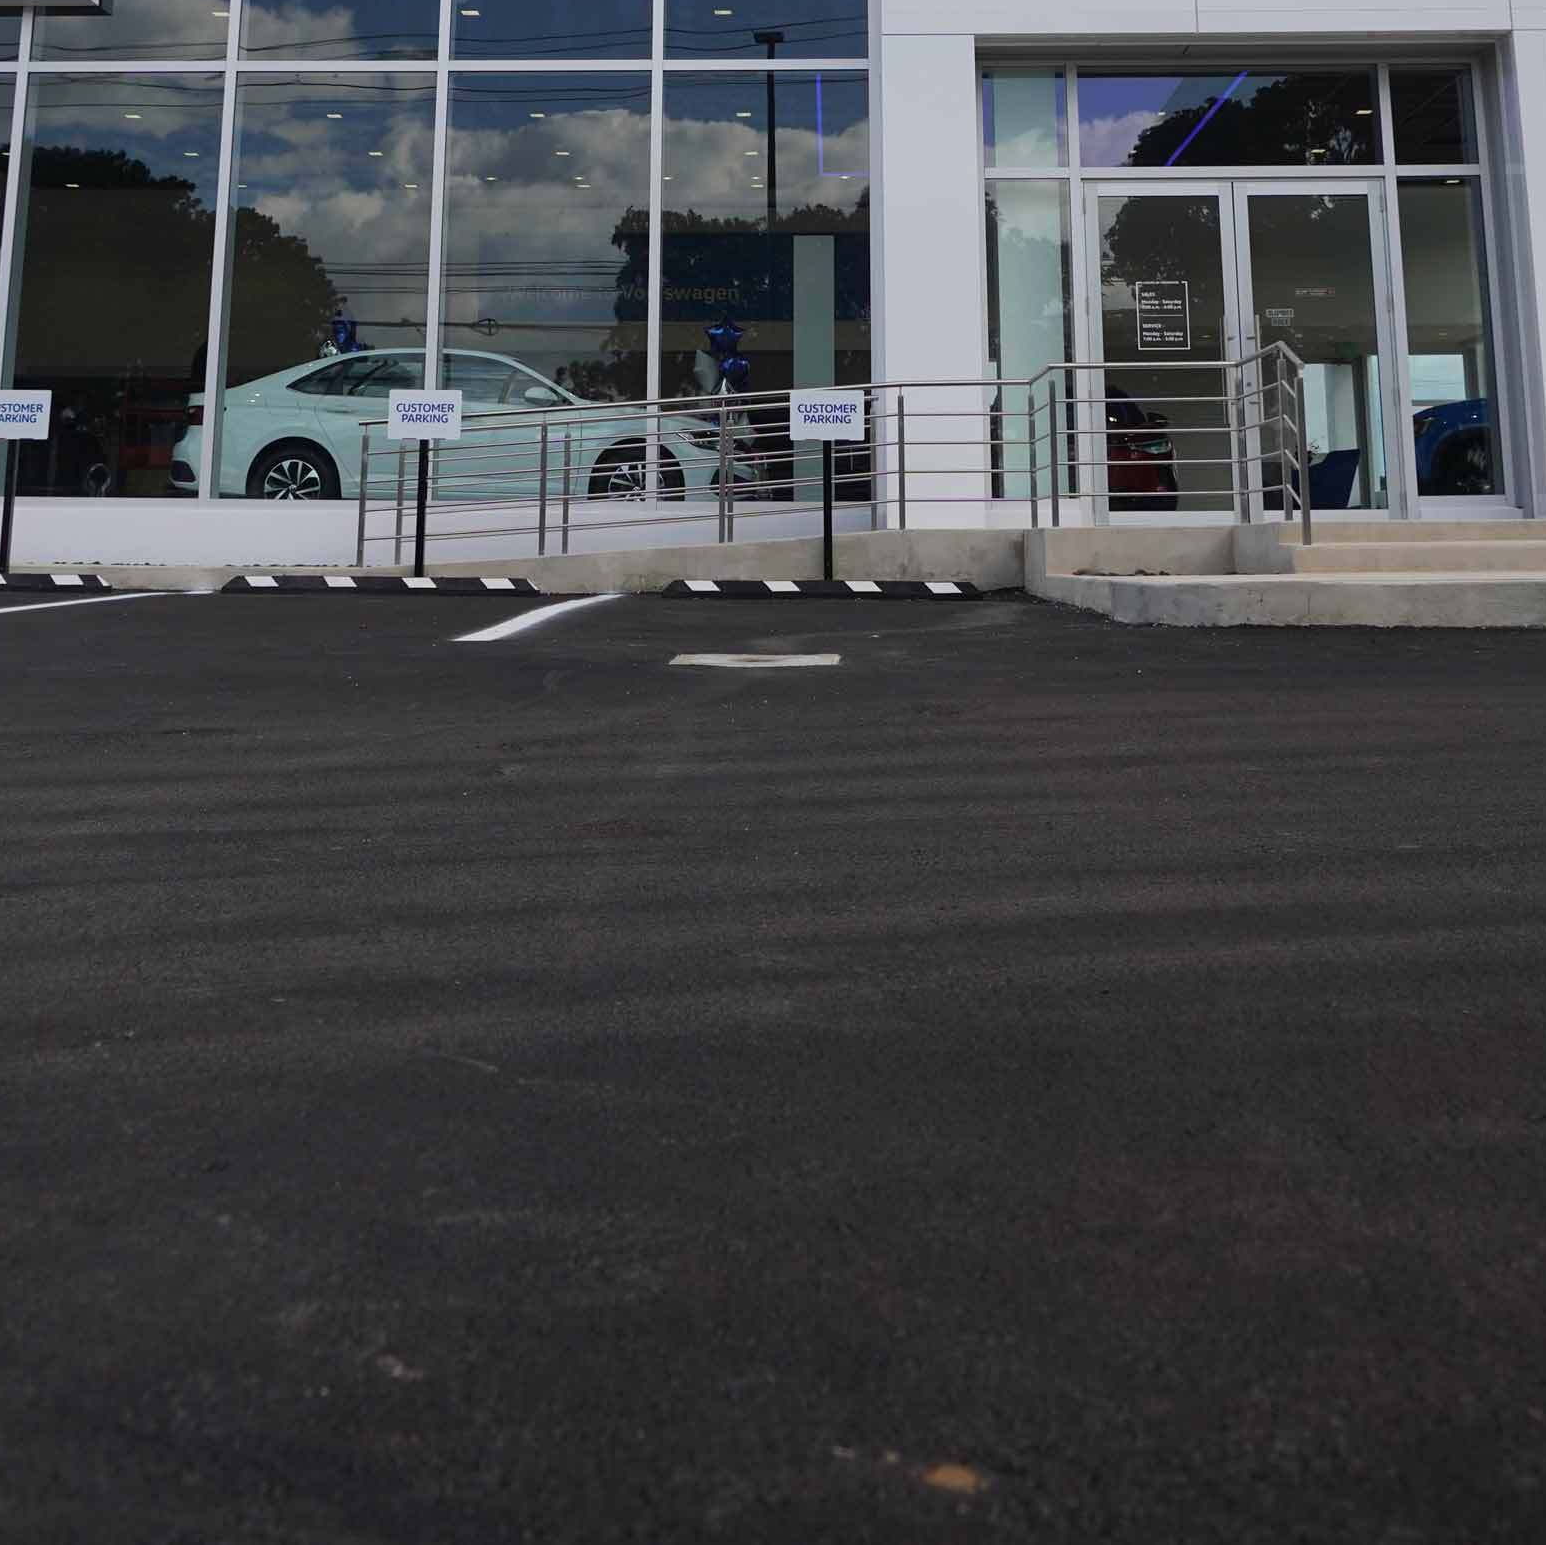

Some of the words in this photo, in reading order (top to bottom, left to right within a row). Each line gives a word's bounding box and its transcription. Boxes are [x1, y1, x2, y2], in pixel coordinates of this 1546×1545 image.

[621, 284, 741, 304] Voswagen
[396, 403, 455, 413] CUSTOMER
[797, 404, 857, 414] CUSTOMER
[401, 413, 448, 423] PARKING
[803, 414, 851, 424] PARKING
